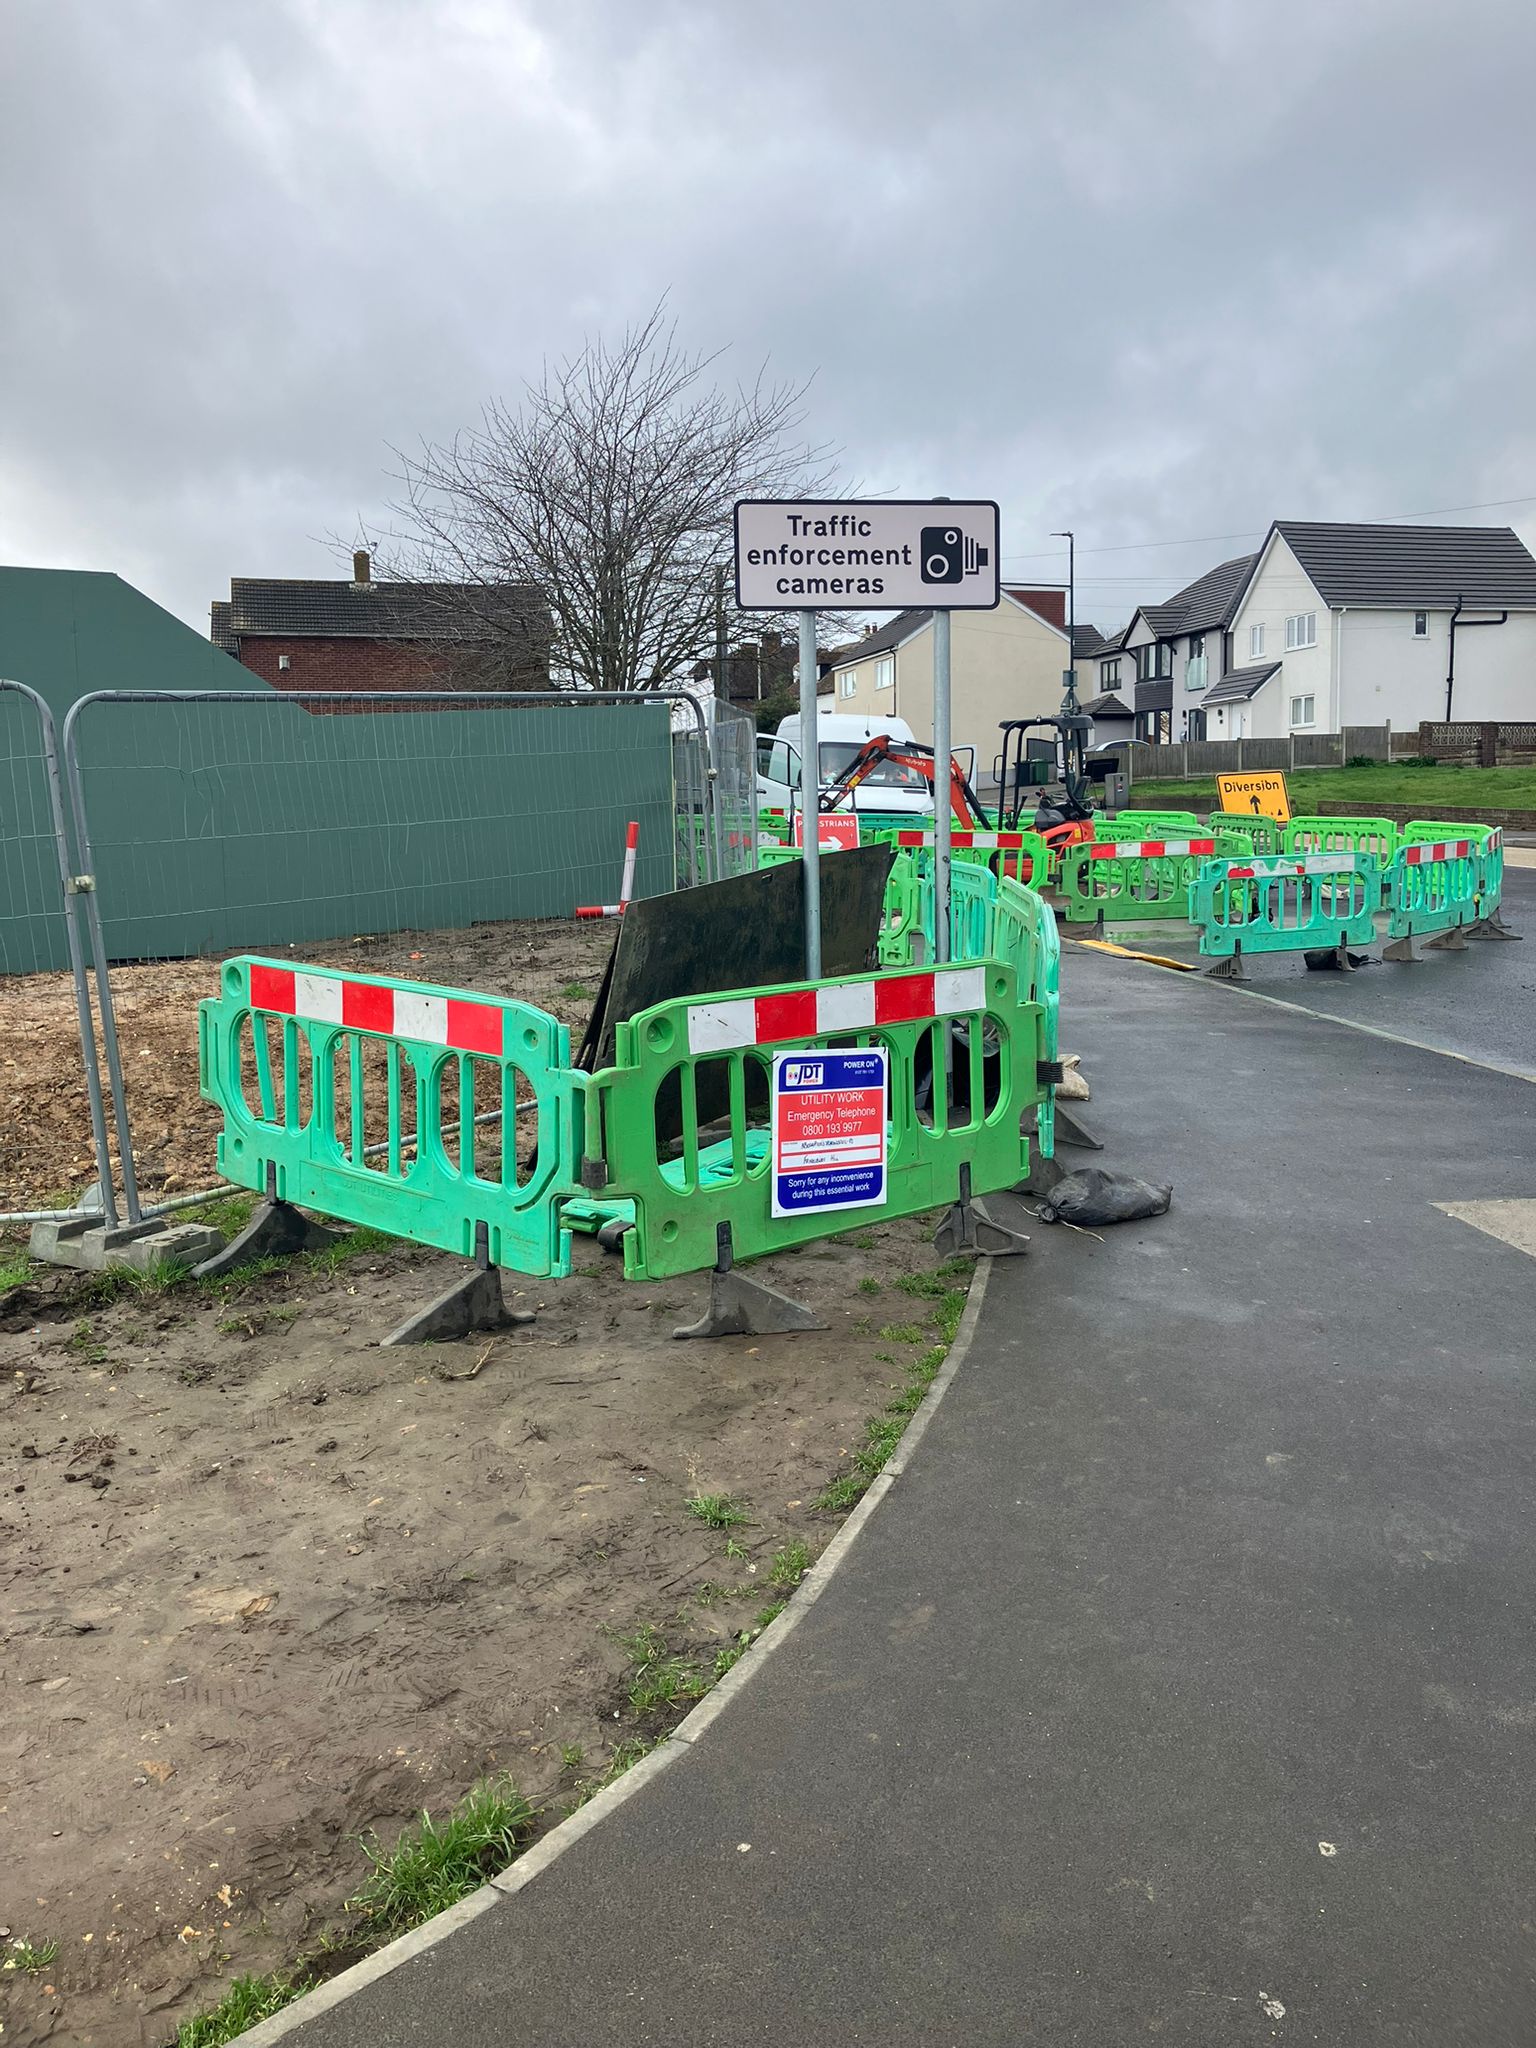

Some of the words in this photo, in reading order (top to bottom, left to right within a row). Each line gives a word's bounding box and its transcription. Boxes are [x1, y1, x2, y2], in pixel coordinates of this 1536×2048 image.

[787, 515, 871, 537] Traffic
[747, 544, 912, 565] enforcement
[776, 577, 884, 594] cameras
[1224, 780, 1279, 793] Diversion
[801, 1093, 835, 1105] UTILITY
[837, 1091, 864, 1102] WORK
[787, 1110, 834, 1122] Emergency
[836, 1107, 876, 1119] Telephone
[802, 1124, 823, 1136] 0800
[827, 1123, 840, 1134] 193
[842, 1121, 862, 1133] 9977
[788, 1178, 806, 1188] Sorry
[807, 1177, 816, 1185] for
[817, 1177, 830, 1185] any
[830, 1172, 874, 1183] inconvenience
[792, 1189, 813, 1199] during
[814, 1187, 826, 1196] this
[827, 1184, 854, 1195] essential
[855, 1182, 870, 1191] work
